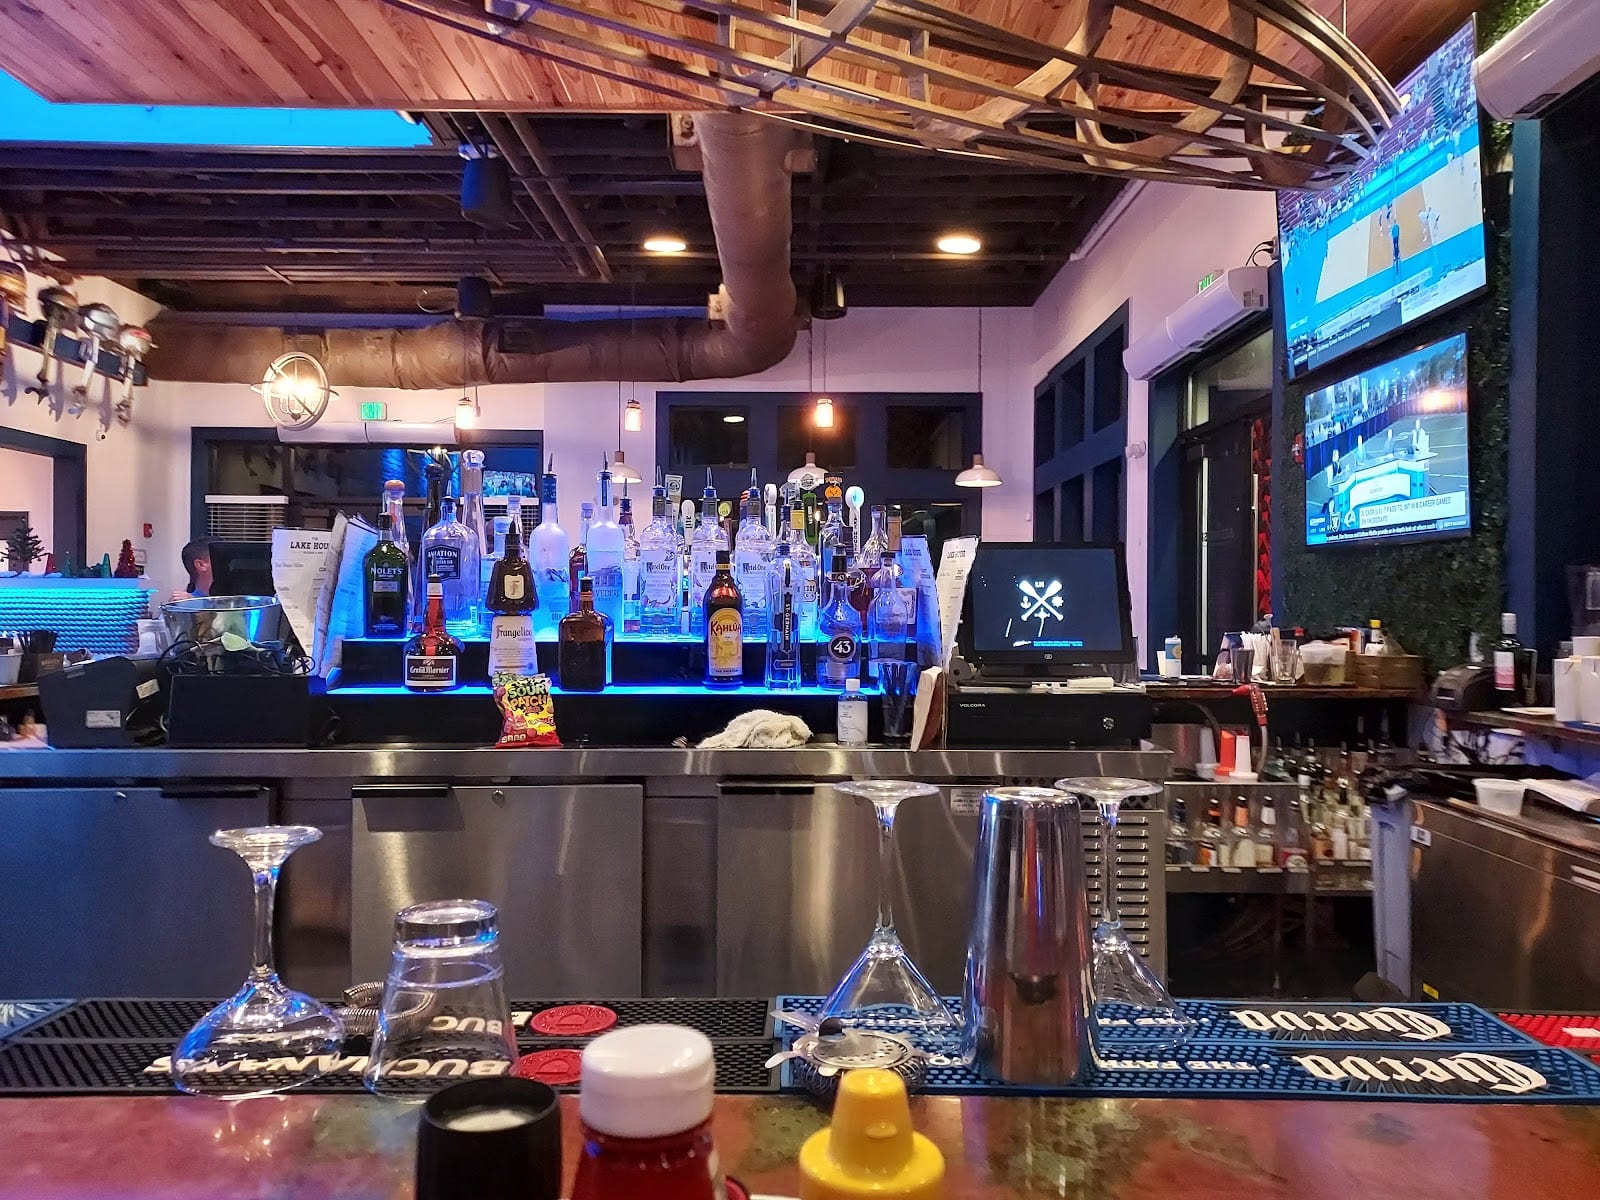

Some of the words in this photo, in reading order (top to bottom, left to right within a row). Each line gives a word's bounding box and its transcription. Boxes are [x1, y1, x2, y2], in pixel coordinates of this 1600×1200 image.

[290, 541, 312, 550] LAKE
[313, 542, 329, 550] HOU
[495, 625, 533, 638] Frangelico
[833, 640, 851, 654] 43
[508, 683, 545, 699] SOUR
[510, 694, 548, 711] PATCH
[1229, 1006, 1452, 1041] Cuervo
[1292, 1051, 1548, 1094] Cuervo
